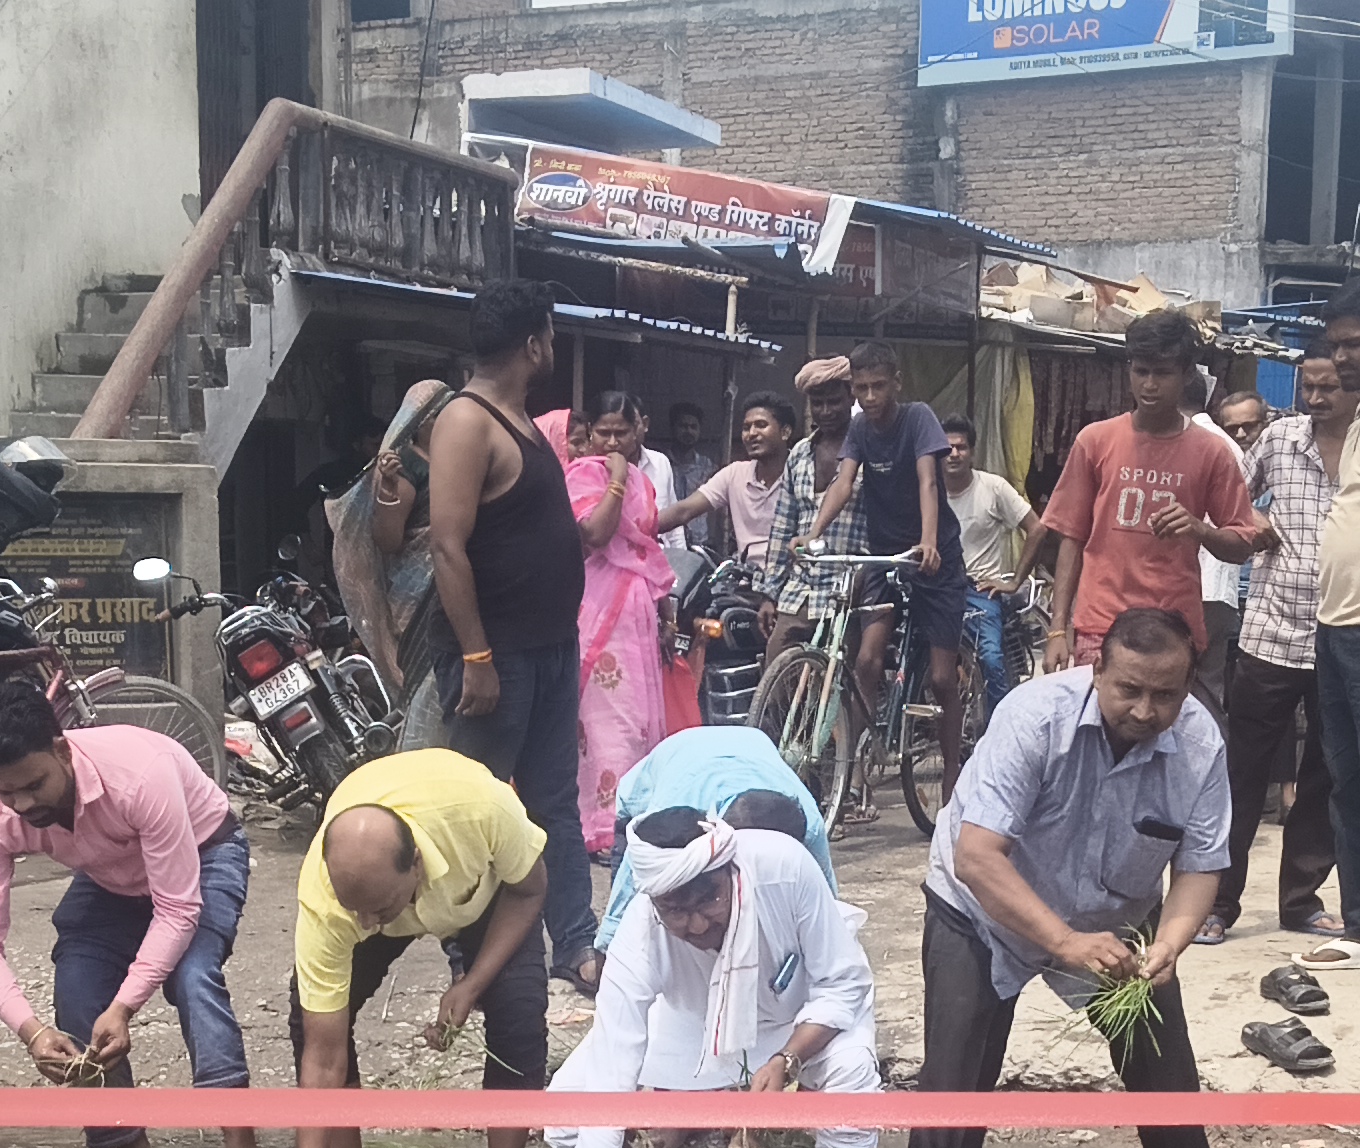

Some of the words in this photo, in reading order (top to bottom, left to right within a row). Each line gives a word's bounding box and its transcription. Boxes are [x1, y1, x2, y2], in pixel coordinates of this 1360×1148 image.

[1012, 19, 1101, 47] SOLAR
[642, 181, 688, 216] पैलेस
[690, 201, 721, 228] एण्ड
[725, 197, 772, 231] गिफ्ट
[1119, 465, 1186, 487] SPORT
[96, 597, 158, 624] प्रसाद
[257, 668, 296, 699] BR28A
